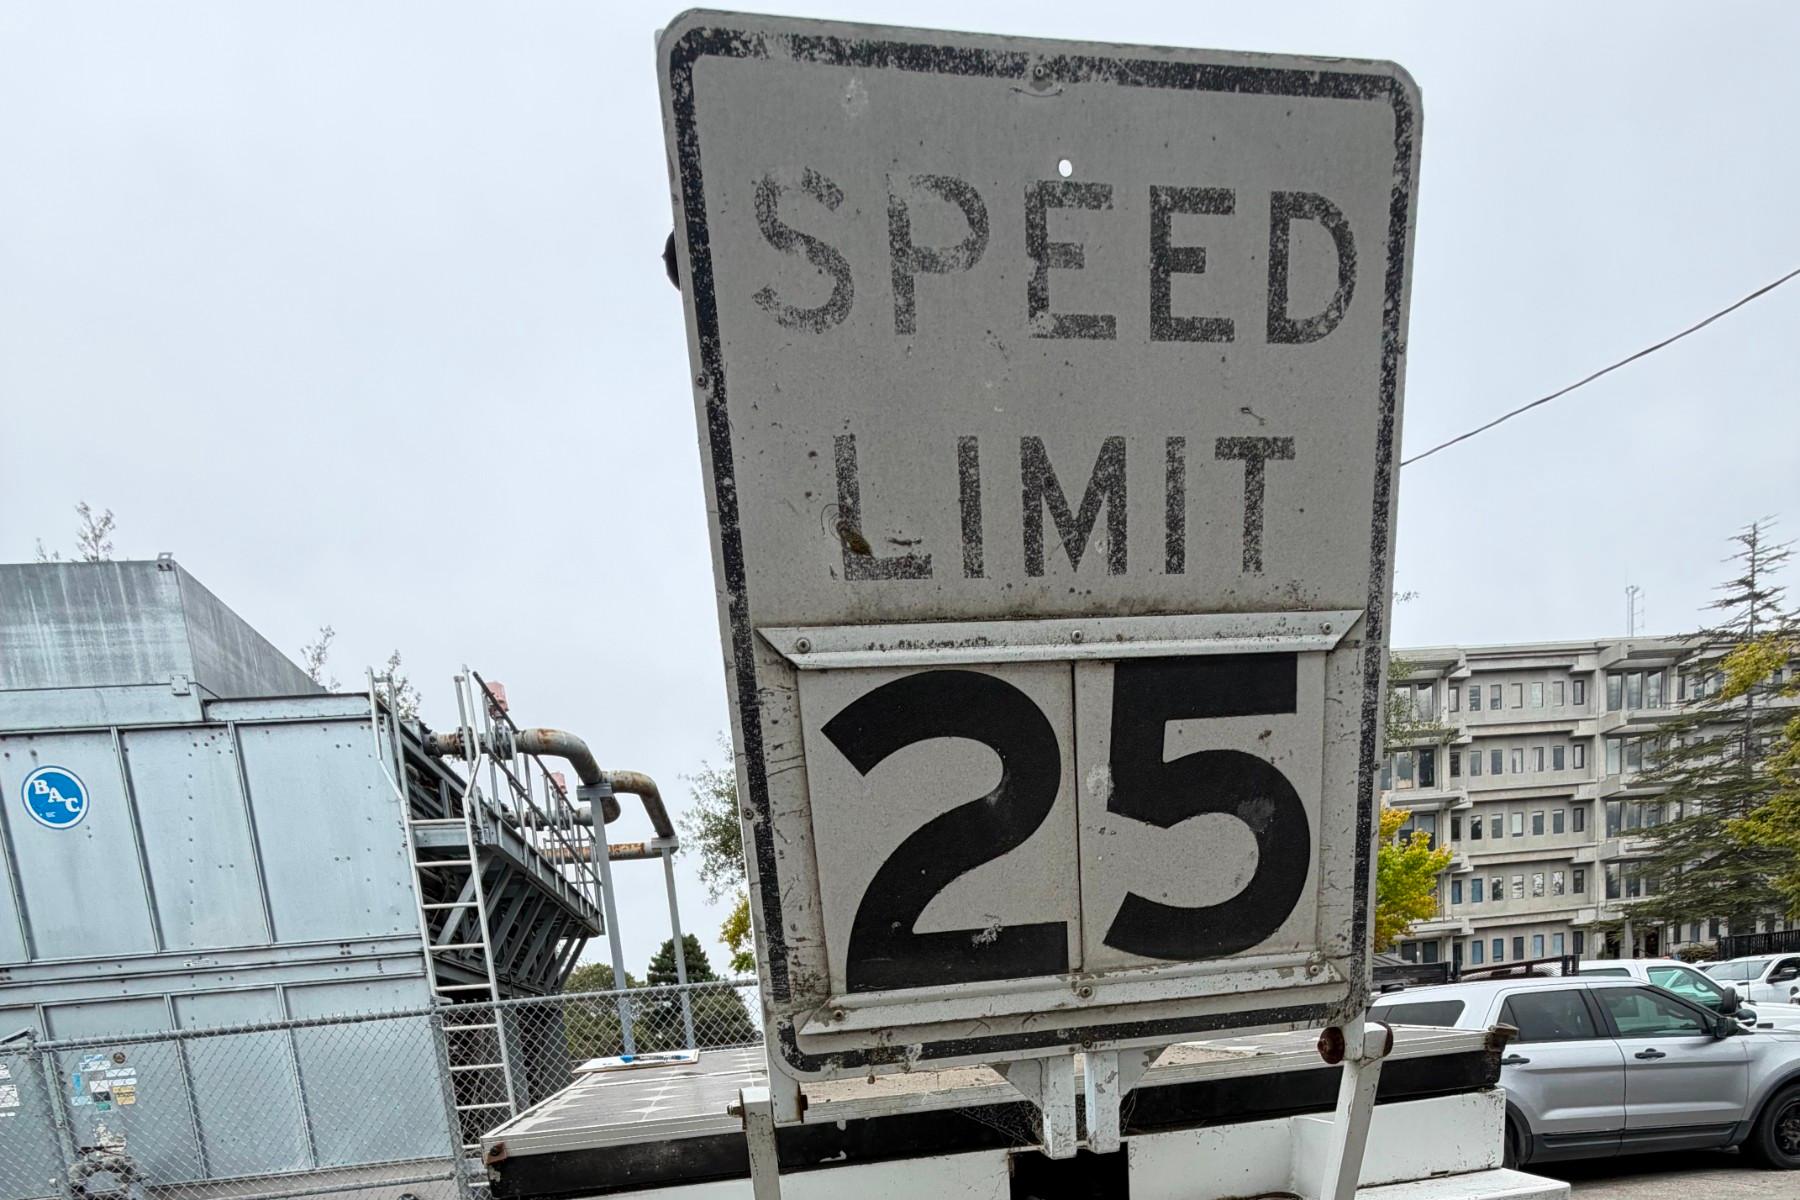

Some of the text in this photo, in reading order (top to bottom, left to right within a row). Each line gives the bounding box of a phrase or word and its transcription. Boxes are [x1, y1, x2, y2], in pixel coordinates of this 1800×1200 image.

[752, 166, 1358, 345] SPEED
[833, 434, 1296, 581] LIMIT
[32, 779, 81, 813] BAC
[821, 651, 1311, 993] 25
